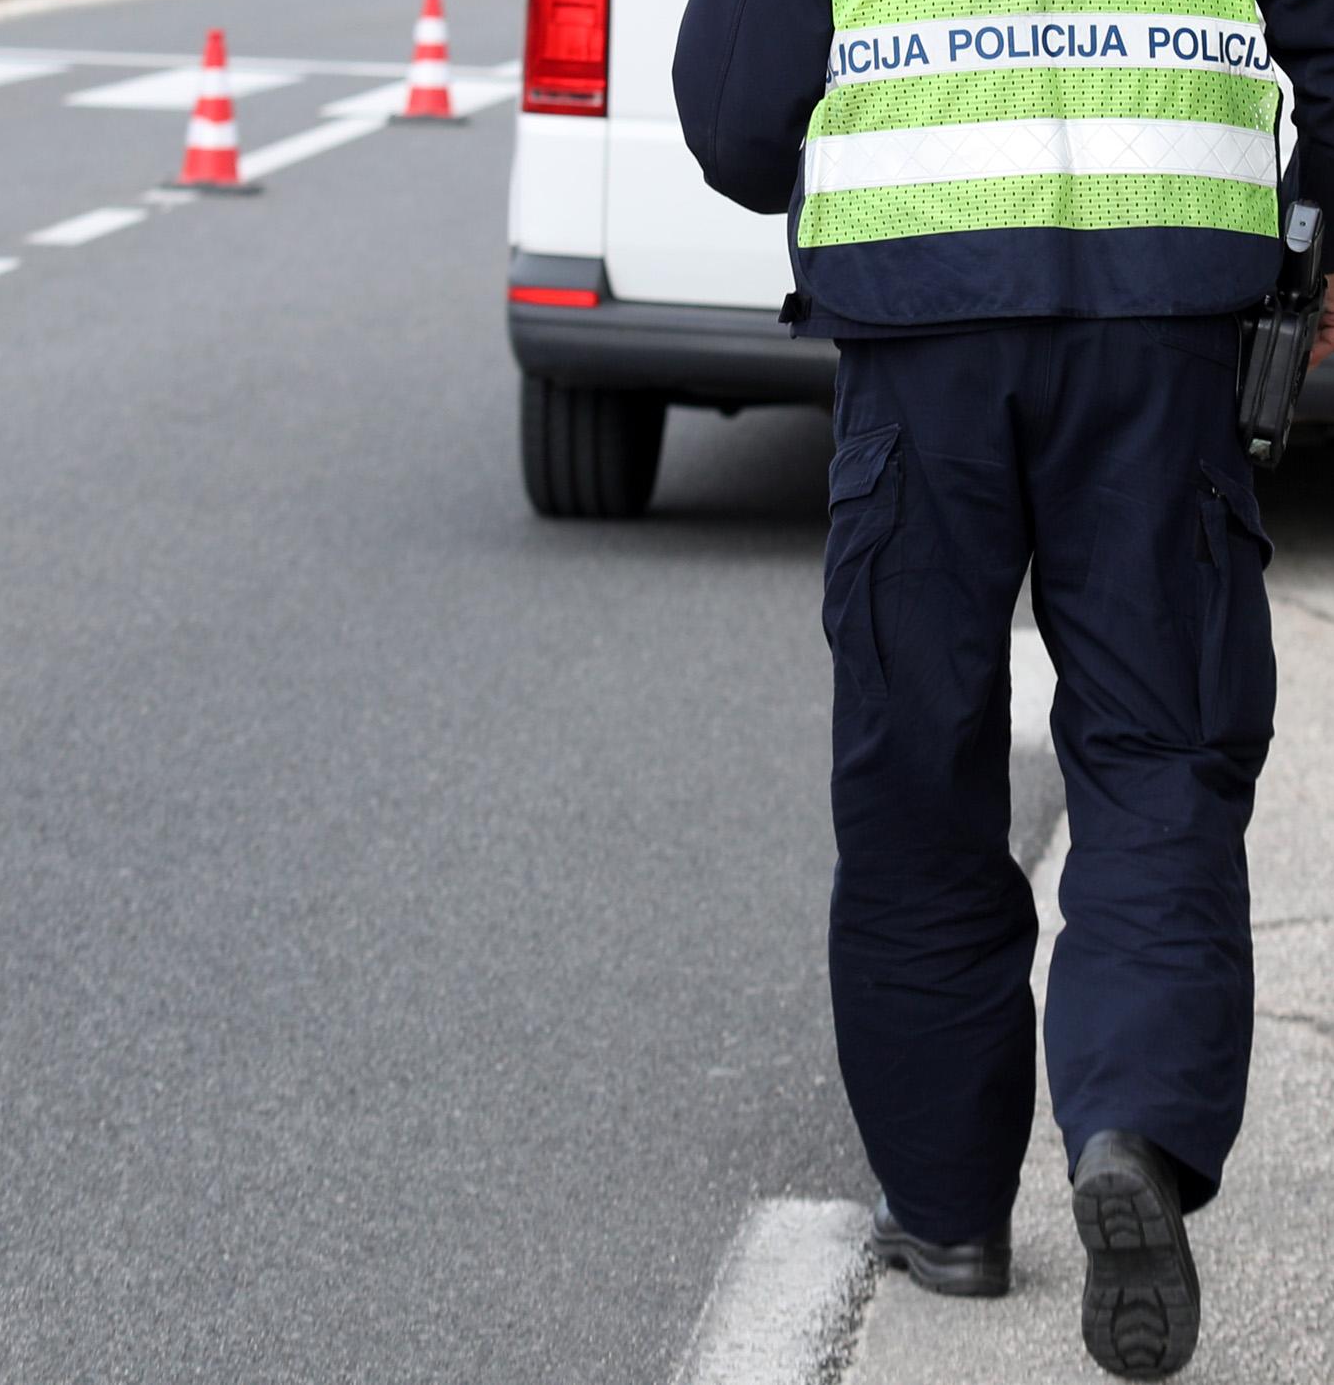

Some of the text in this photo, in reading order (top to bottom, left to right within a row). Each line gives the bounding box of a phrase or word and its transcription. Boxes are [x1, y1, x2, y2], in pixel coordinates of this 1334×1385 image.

[827, 24, 1271, 82] LICIJA POLICIJA POLICIJ
